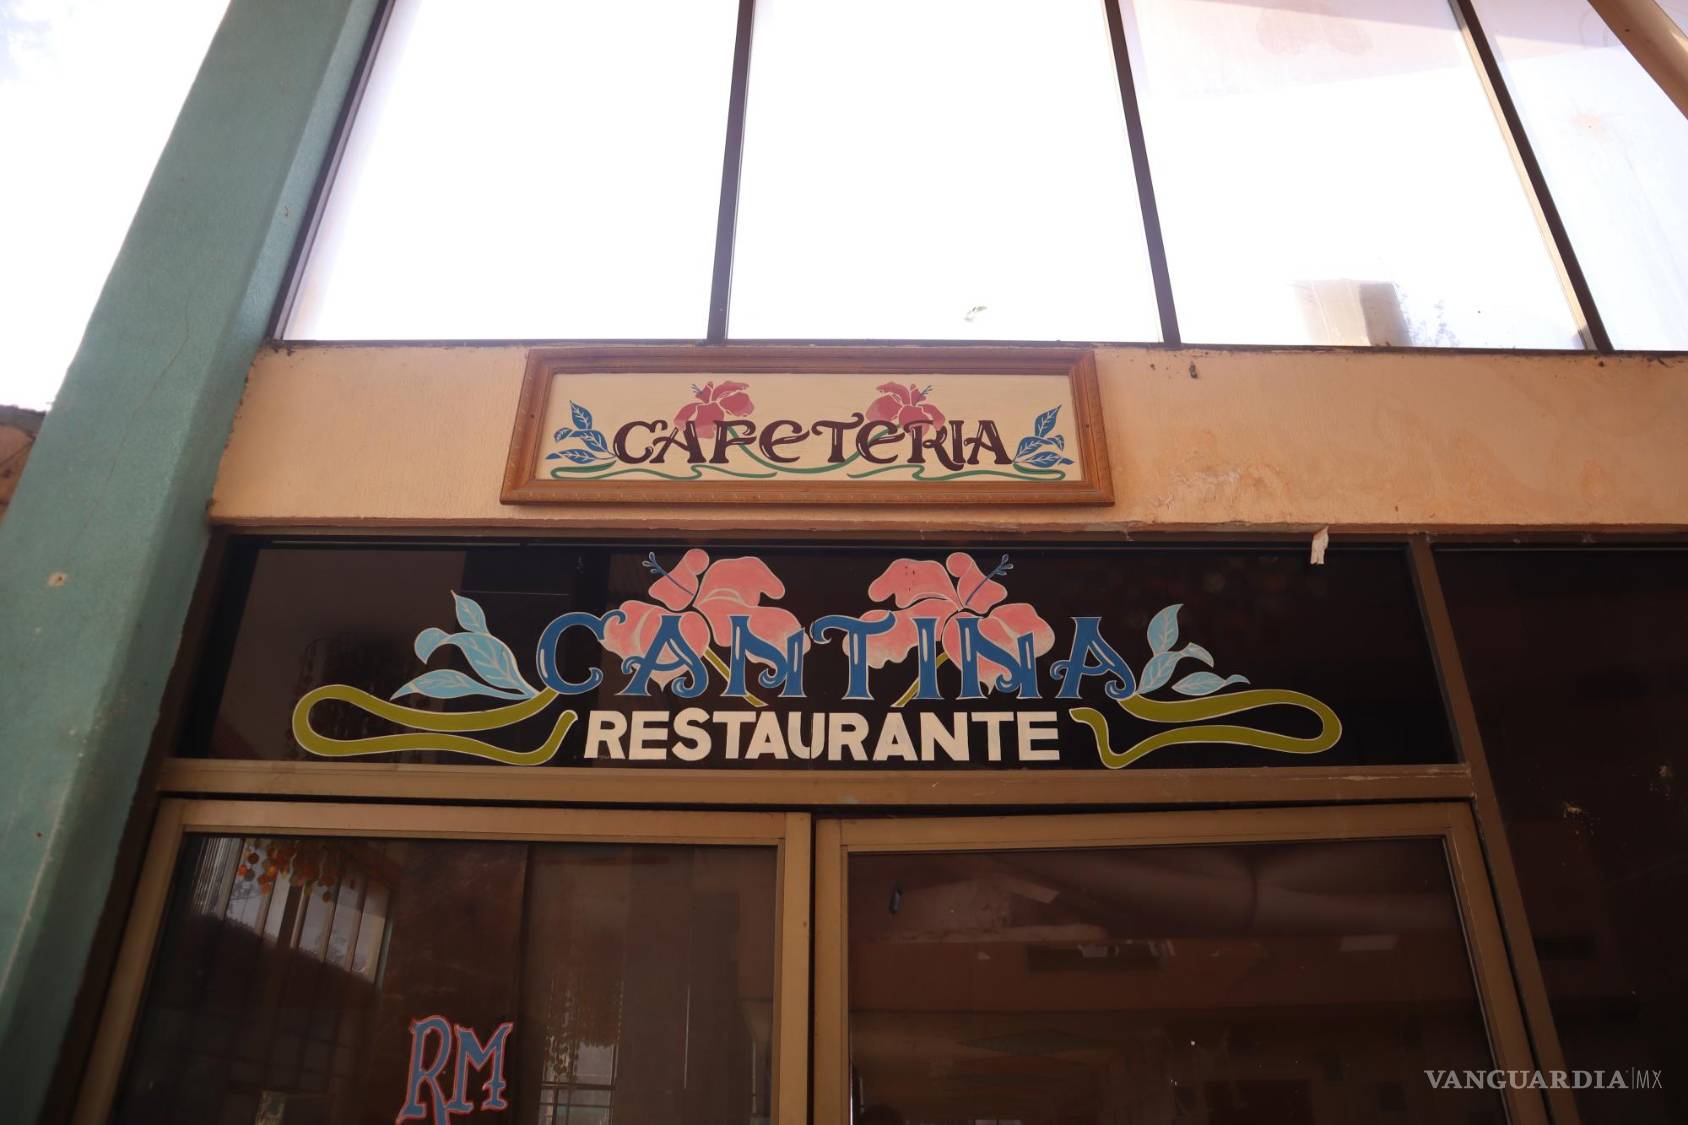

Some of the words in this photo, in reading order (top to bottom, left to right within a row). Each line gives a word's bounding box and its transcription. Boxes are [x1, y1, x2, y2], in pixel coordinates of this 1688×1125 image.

[612, 412, 1013, 472] CAFETERIA
[535, 610, 1137, 700] CANTINA
[583, 708, 1060, 762] RESTAURANTE
[395, 1014, 514, 1125] RM
